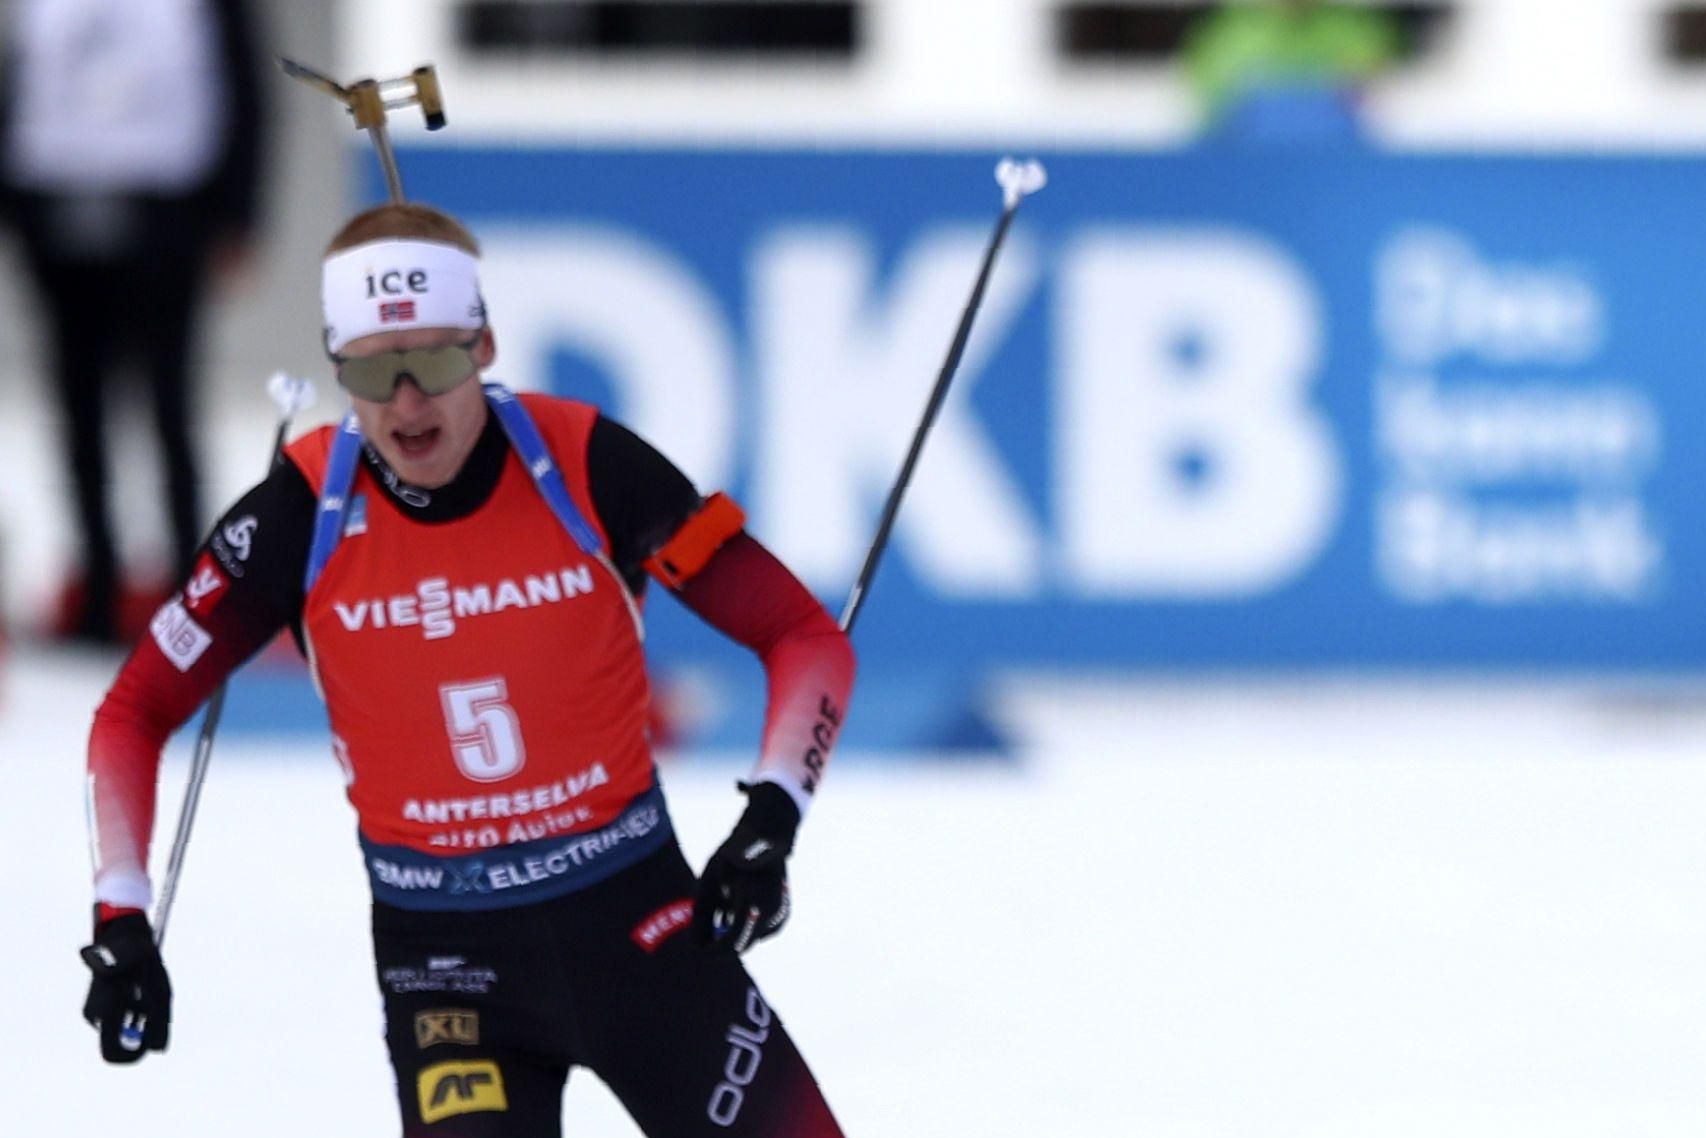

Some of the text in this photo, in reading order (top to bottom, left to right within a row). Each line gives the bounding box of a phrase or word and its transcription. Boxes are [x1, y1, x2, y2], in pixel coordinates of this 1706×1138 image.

[364, 266, 428, 298] ice
[458, 222, 1346, 604] DKB
[334, 564, 595, 641] VIESSMANN
[438, 676, 527, 784] 5
[403, 762, 611, 824] ANTERSELVA
[371, 857, 445, 890] BMW
[488, 806, 662, 890] ELECTRIFIED
[706, 984, 772, 1128] odlo
